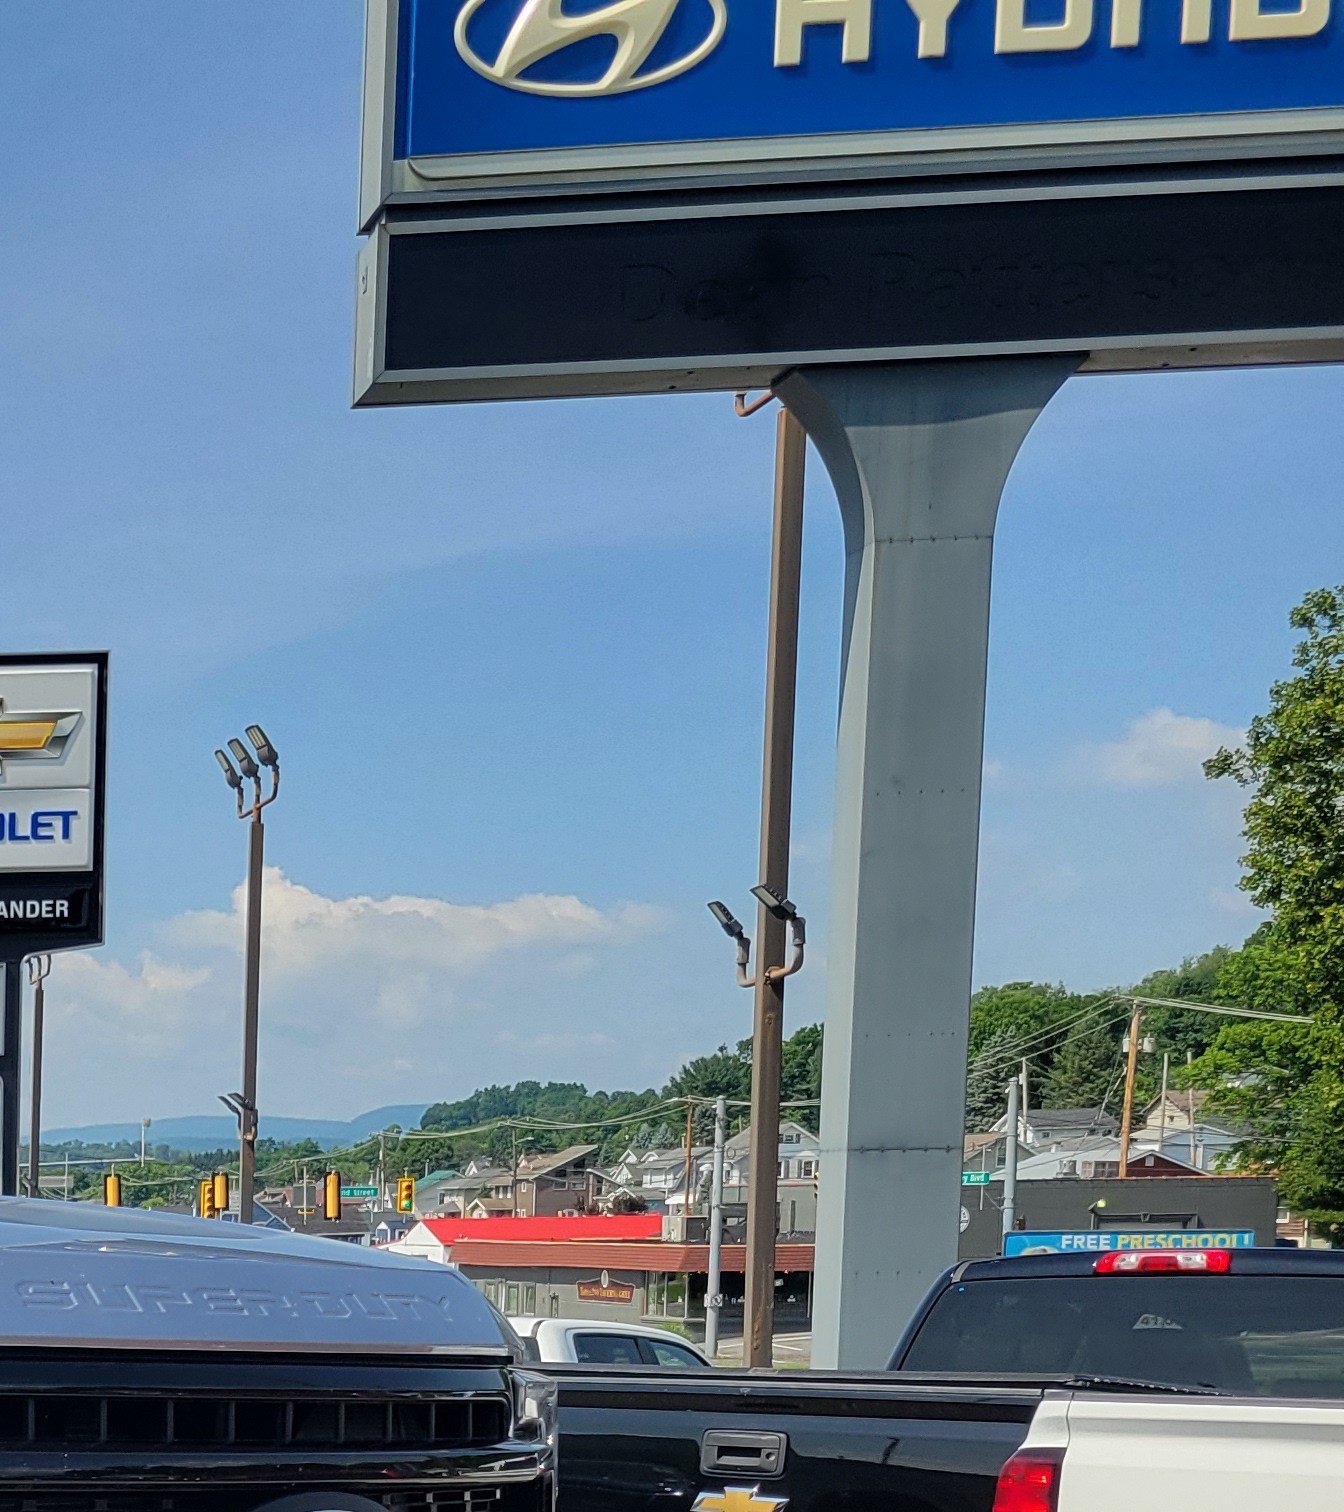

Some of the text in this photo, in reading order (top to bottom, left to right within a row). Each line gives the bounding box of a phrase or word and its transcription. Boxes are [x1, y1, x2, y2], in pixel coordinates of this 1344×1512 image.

[1061, 1234, 1111, 1249] FREE
[16, 1281, 454, 1321] SUPER DUTY
